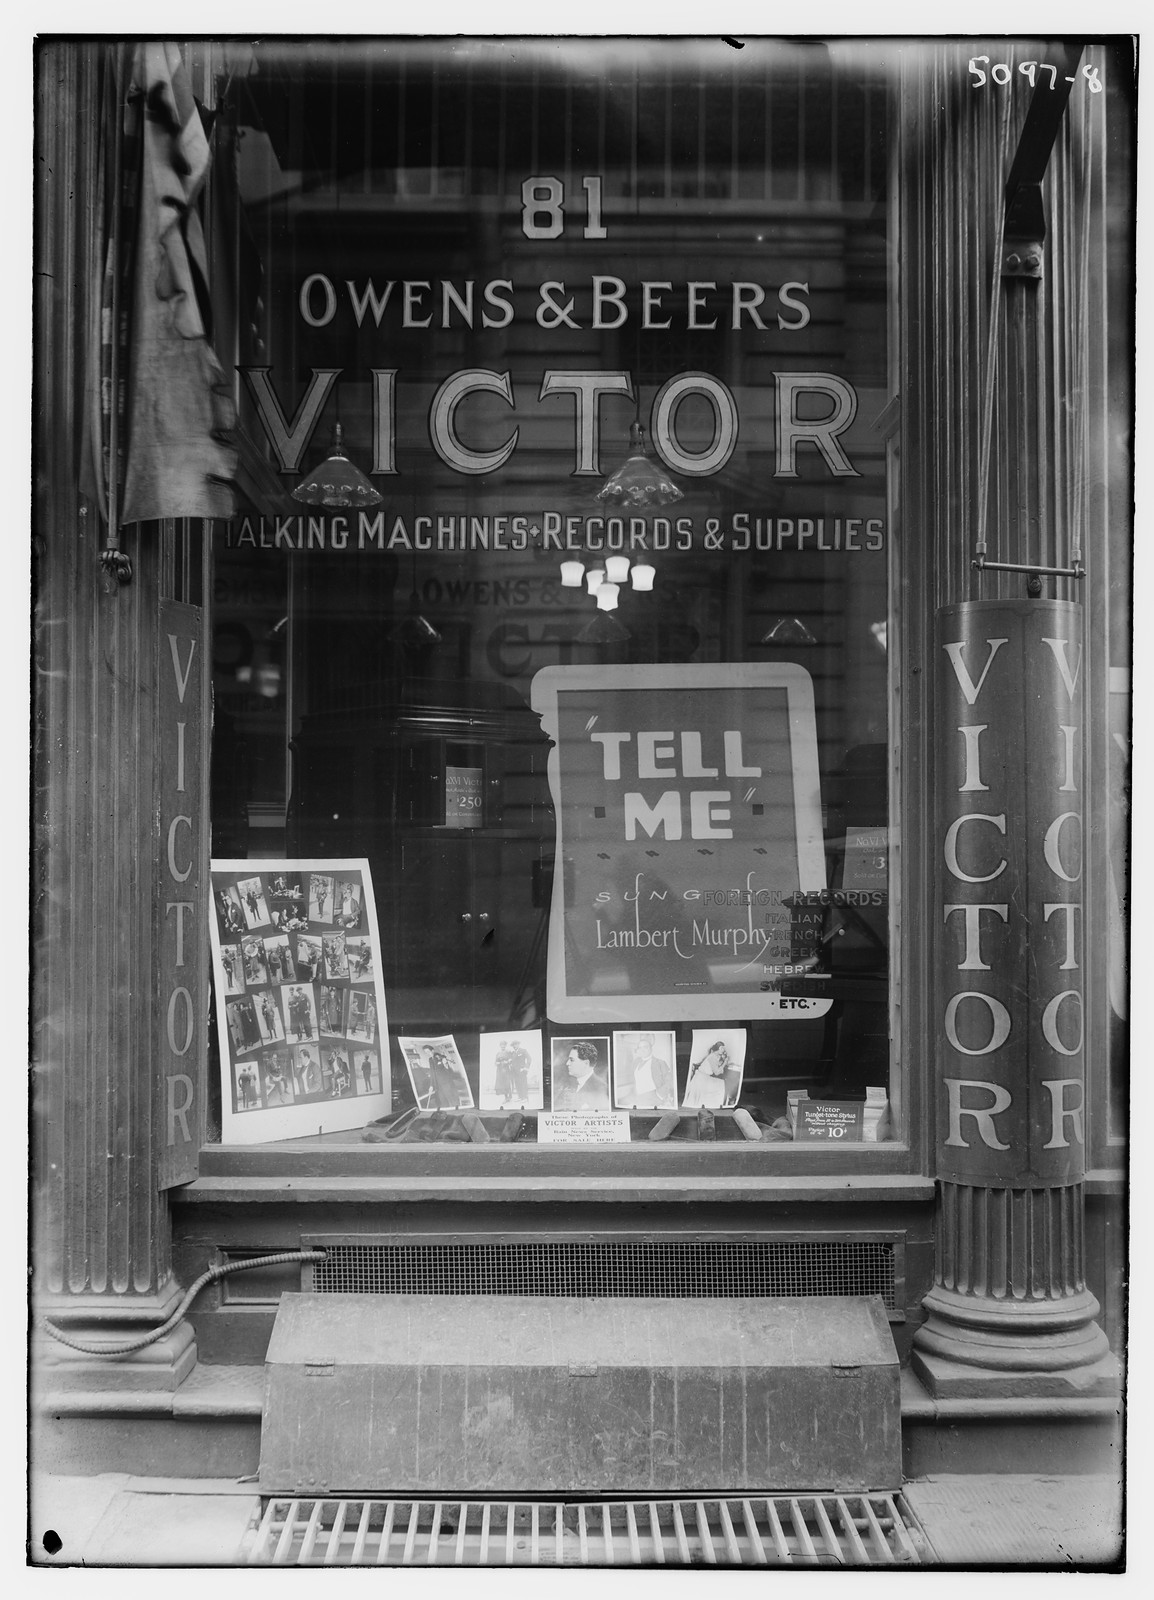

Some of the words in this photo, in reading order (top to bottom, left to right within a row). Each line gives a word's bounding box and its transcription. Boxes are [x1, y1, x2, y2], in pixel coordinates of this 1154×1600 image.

[520, 175, 607, 240] 81
[299, 273, 515, 331] OWENS
[534, 280, 583, 331] &
[590, 274, 812, 330] BEERS
[235, 365, 862, 478] VICTOR
[357, 511, 528, 551] MACHINES
[541, 511, 694, 552] RECORDS
[703, 515, 726, 551] &
[731, 512, 885, 552] SUPPLIES
[165, 633, 195, 1147] VICTOR
[595, 889, 702, 903] SUNG
[703, 890, 783, 907] FOREIGN
[793, 890, 884, 907] RECORDS
[942, 638, 1013, 1151] VICTOR
[596, 872, 694, 959] Lambert
[691, 871, 775, 974] Murphy
[765, 913, 823, 924] ITALIAN
[766, 929, 823, 941] FRENCH
[779, 998, 810, 1010] ETC.
